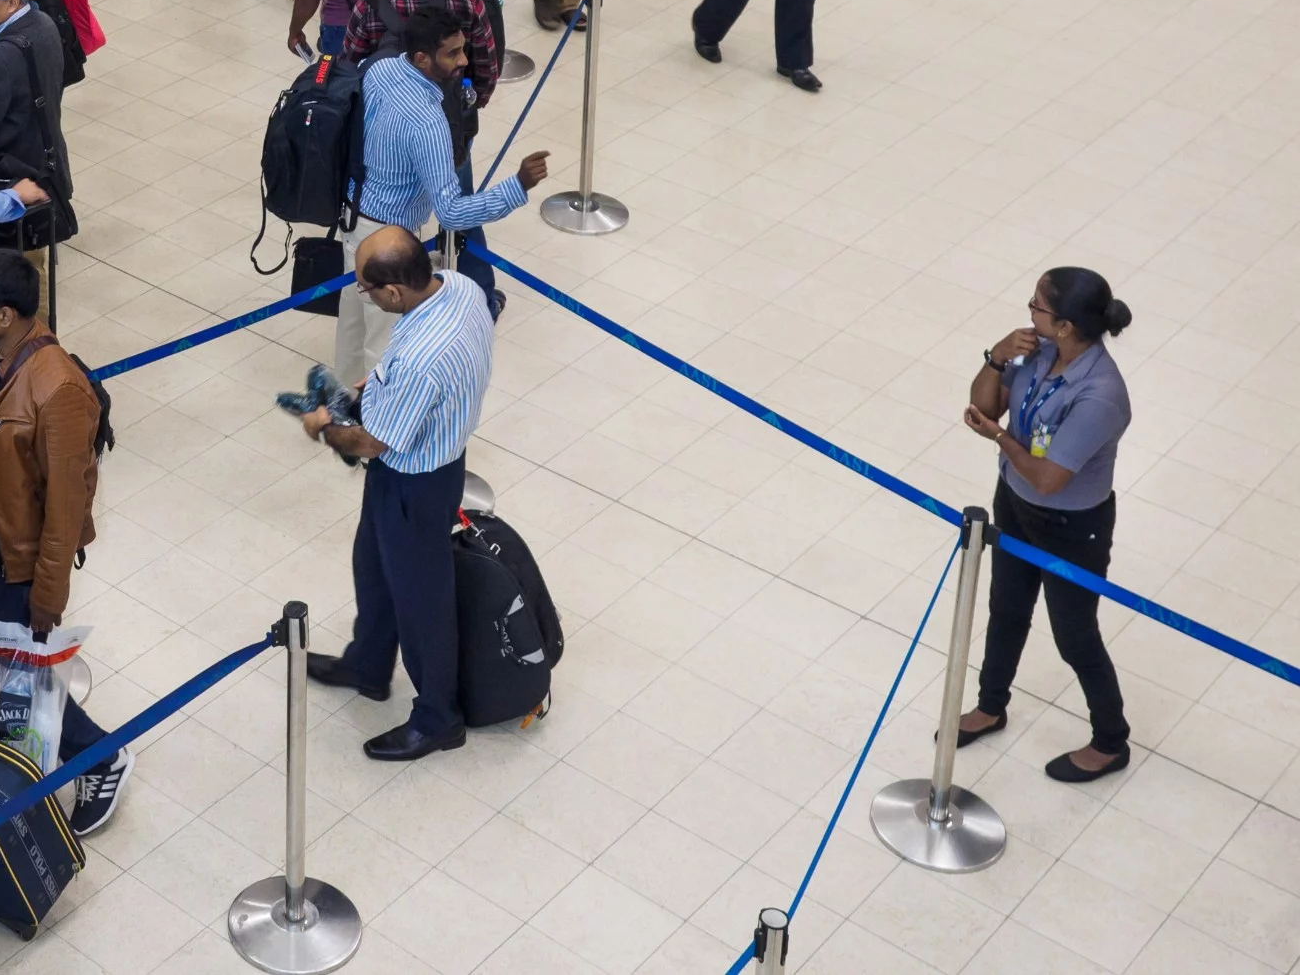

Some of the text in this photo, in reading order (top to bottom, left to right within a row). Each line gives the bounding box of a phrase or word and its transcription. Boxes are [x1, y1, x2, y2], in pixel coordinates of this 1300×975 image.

[315, 60, 329, 84] SWISS
[680, 362, 722, 396] AASL
[828, 444, 874, 479] AASL
[1135, 598, 1197, 637] AASL
[0, 708, 22, 722] JACK
[29, 845, 47, 876] POLO
